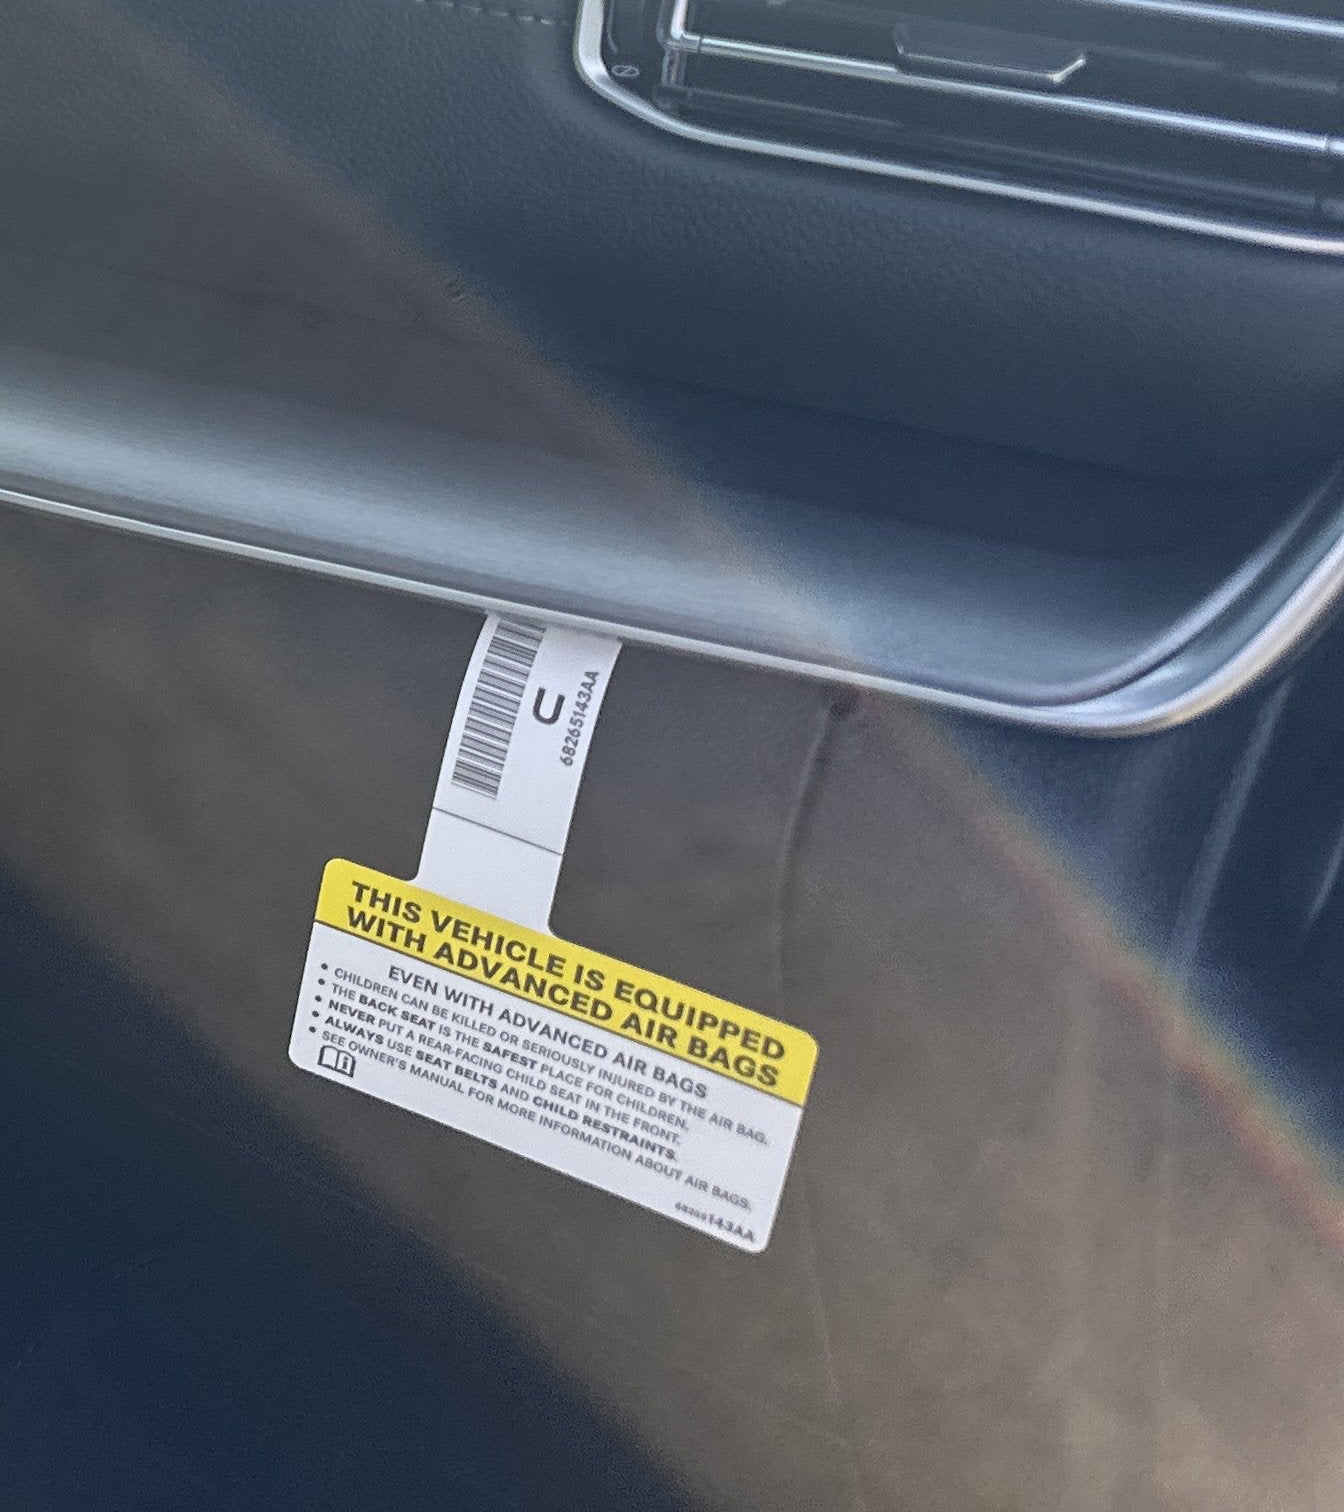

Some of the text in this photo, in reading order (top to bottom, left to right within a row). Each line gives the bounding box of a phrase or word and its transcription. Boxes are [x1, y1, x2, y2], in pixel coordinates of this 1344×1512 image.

[560, 670, 600, 767] 68265143AA
[343, 904, 782, 1090] WITH ADVANCED AIR BAGS
[348, 879, 789, 1063] THIS VEHICLE IS EQUIPPED
[388, 964, 708, 1100] EVEN WITH ADVANCED AIR BAGS
[324, 1013, 385, 1046] ALWAYS
[385, 1036, 413, 1057] USE
[414, 1048, 453, 1072] SEAT
[453, 1063, 499, 1090] BELTS
[499, 1081, 530, 1103] AND
[531, 1094, 580, 1122] CHILD
[328, 981, 357, 1002] THE
[357, 992, 399, 1018] BACK
[399, 1008, 437, 1032] SEAT
[437, 1023, 453, 1039] IS
[452, 1028, 481, 1049] THE
[481, 1039, 539, 1072] SAFEST
[538, 1061, 584, 1089] PLACE
[584, 1079, 615, 1101] FOR
[328, 998, 376, 1026] NEVER
[377, 1017, 403, 1037] PUT
[405, 1027, 416, 1041] A
[417, 1032, 503, 1075] REAR-FACING
[504, 1065, 547, 1092] CHILD
[548, 1082, 583, 1106] SEAT
[584, 1097, 601, 1114] IN
[602, 1104, 630, 1125] THE
[333, 966, 399, 1001] CHILDREN
[400, 991, 429, 1012] CAN
[430, 1003, 449, 1020] BE
[450, 1010, 497, 1038] KILLED
[498, 1029, 519, 1047] OR
[520, 1037, 596, 1076] SERIOUSLY
[596, 1066, 657, 1100] INJURED
[657, 1090, 678, 1108] BY
[677, 1098, 707, 1120] THE
[707, 1111, 734, 1132] AIR
[319, 1028, 347, 1051] SEE
[346, 1038, 408, 1072] OWNER'S
[408, 1063, 467, 1095] MANUAL
[466, 1085, 496, 1107] FOR
[495, 1097, 538, 1123] MORE
[537, 1113, 635, 1162] INFORMATION
[633, 1152, 684, 1182] ABOUT
[682, 1173, 711, 1193] AIR
